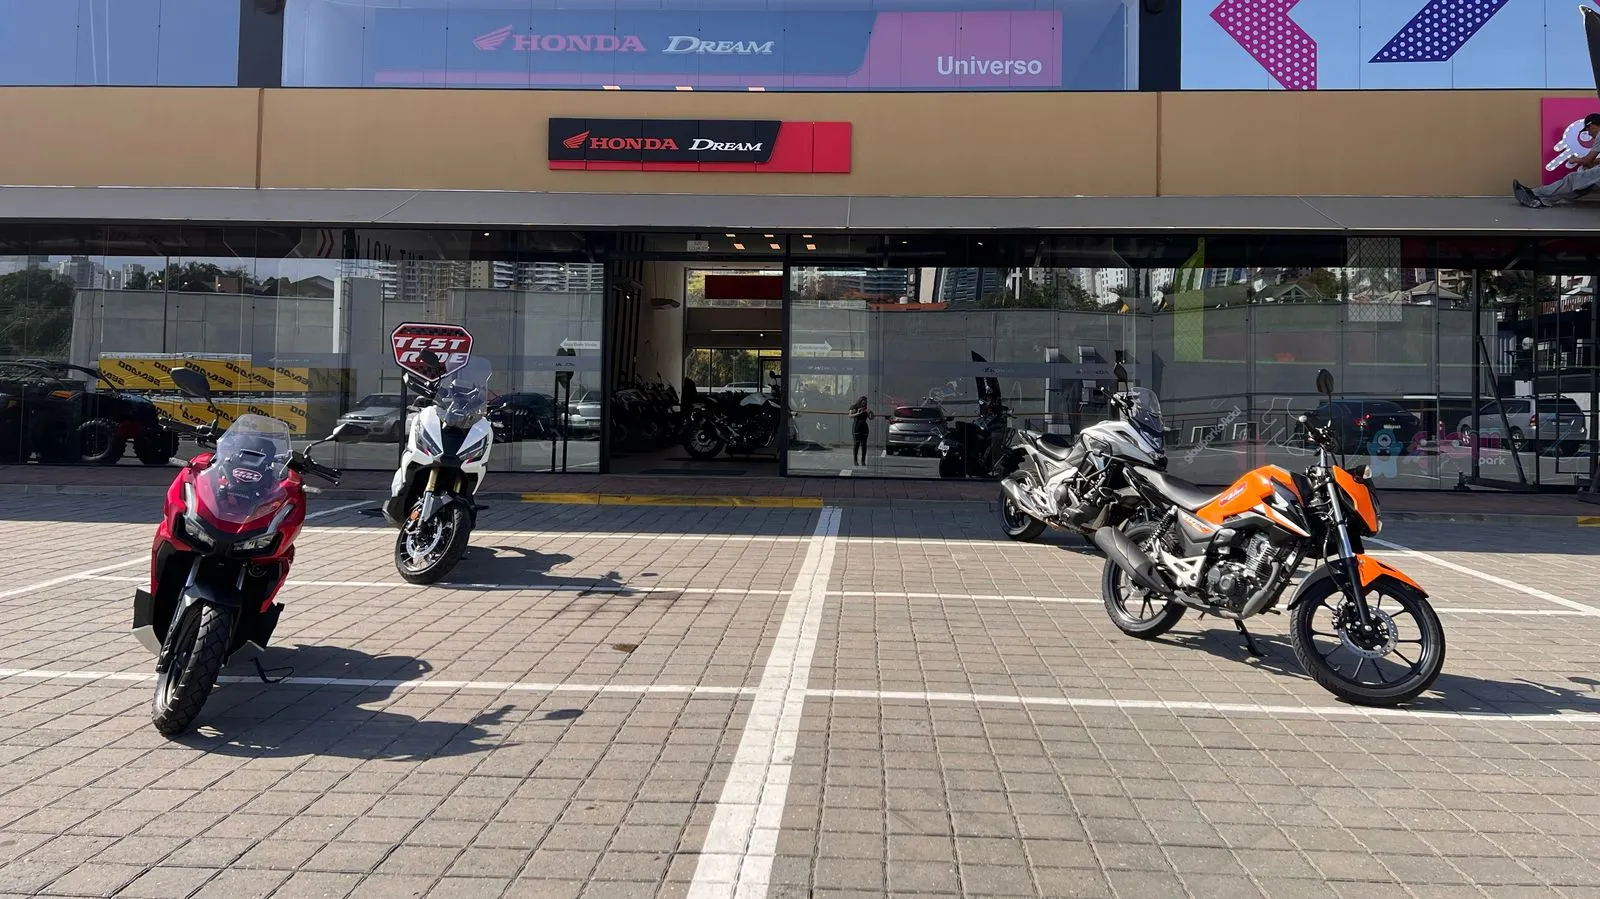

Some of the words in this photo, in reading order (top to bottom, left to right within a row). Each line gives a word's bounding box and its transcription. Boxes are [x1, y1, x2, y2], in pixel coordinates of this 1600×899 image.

[513, 34, 647, 53] HONDA
[936, 54, 1044, 78] Universo
[589, 136, 679, 151] HONDA
[394, 336, 466, 350] TEST
[1478, 456, 1507, 467] park
